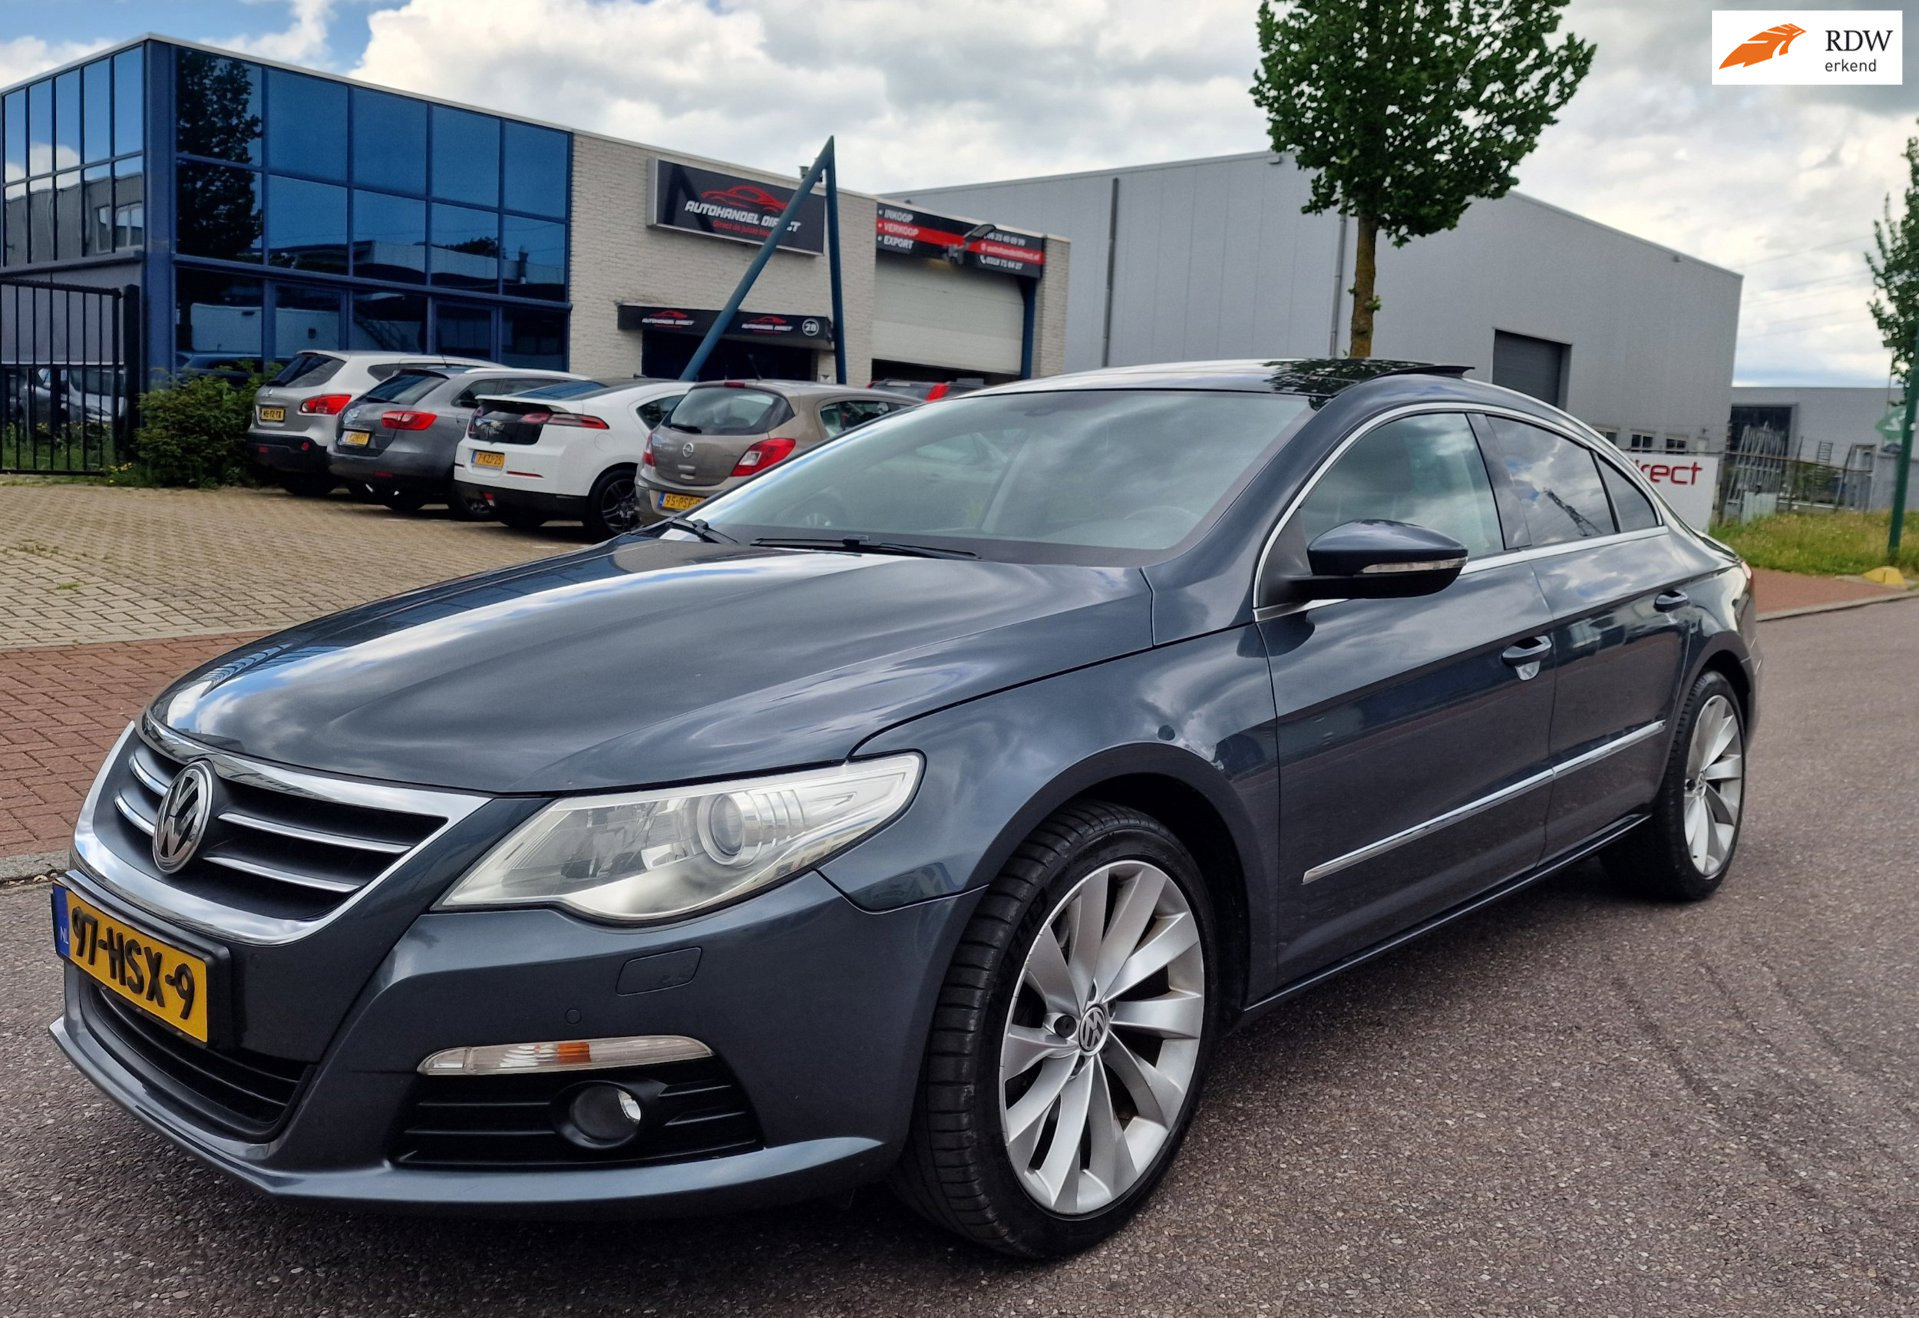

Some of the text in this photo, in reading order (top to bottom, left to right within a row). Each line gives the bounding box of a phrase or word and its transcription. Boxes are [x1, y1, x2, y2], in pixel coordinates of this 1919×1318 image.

[684, 200, 760, 224] AUTOHANDEL
[884, 222, 919, 237] VERKOOP
[883, 235, 914, 250] EXPORT
[805, 322, 817, 332] 28
[60, 906, 196, 1021] NL 97-HSX-9
